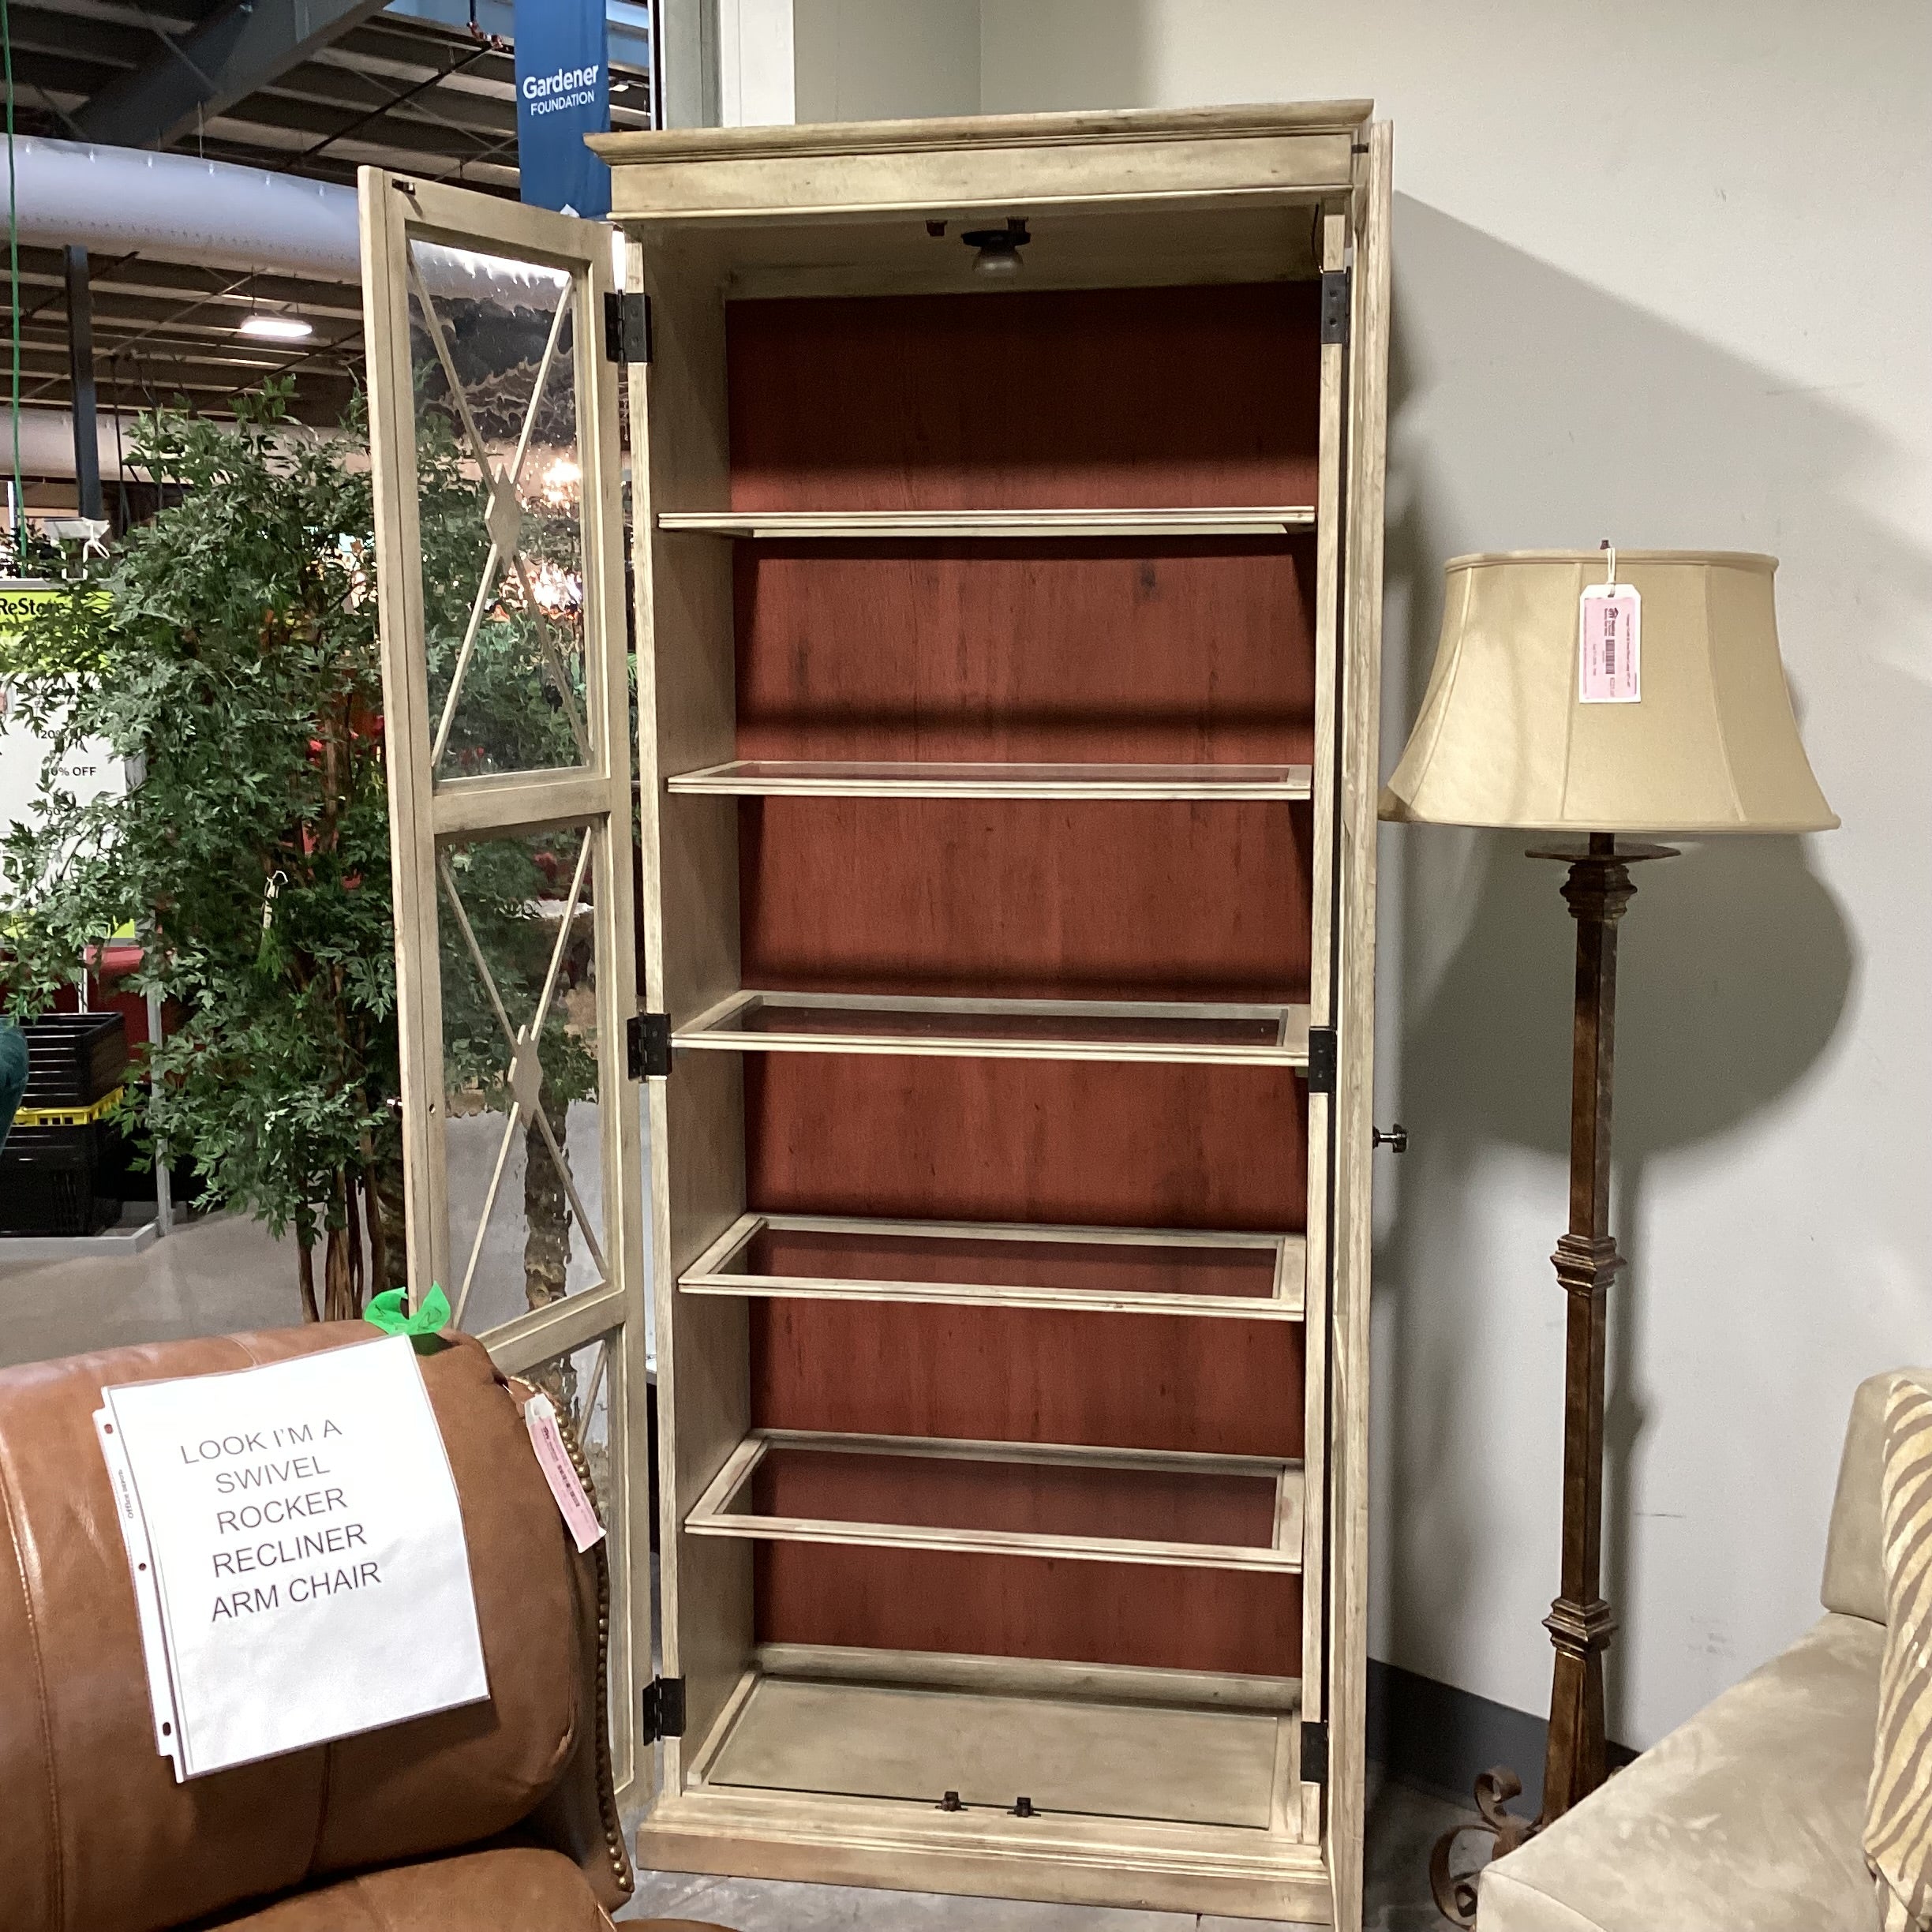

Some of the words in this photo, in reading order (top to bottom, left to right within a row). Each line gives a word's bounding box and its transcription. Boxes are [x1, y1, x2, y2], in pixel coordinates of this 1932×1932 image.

[522, 65, 599, 99] Gardener
[530, 89, 594, 116] FOUNDATION
[44, 766, 69, 777] 0%
[73, 766, 96, 777] OFF
[180, 1432, 268, 1464] LOOK
[273, 1424, 313, 1447] I'M
[324, 1419, 343, 1438] A
[215, 1455, 331, 1493] SWIVEL
[217, 1488, 348, 1534] ROCKER
[212, 1523, 367, 1578] RECLINER
[212, 1584, 279, 1623] ARM
[289, 1562, 382, 1602] CHAIR
